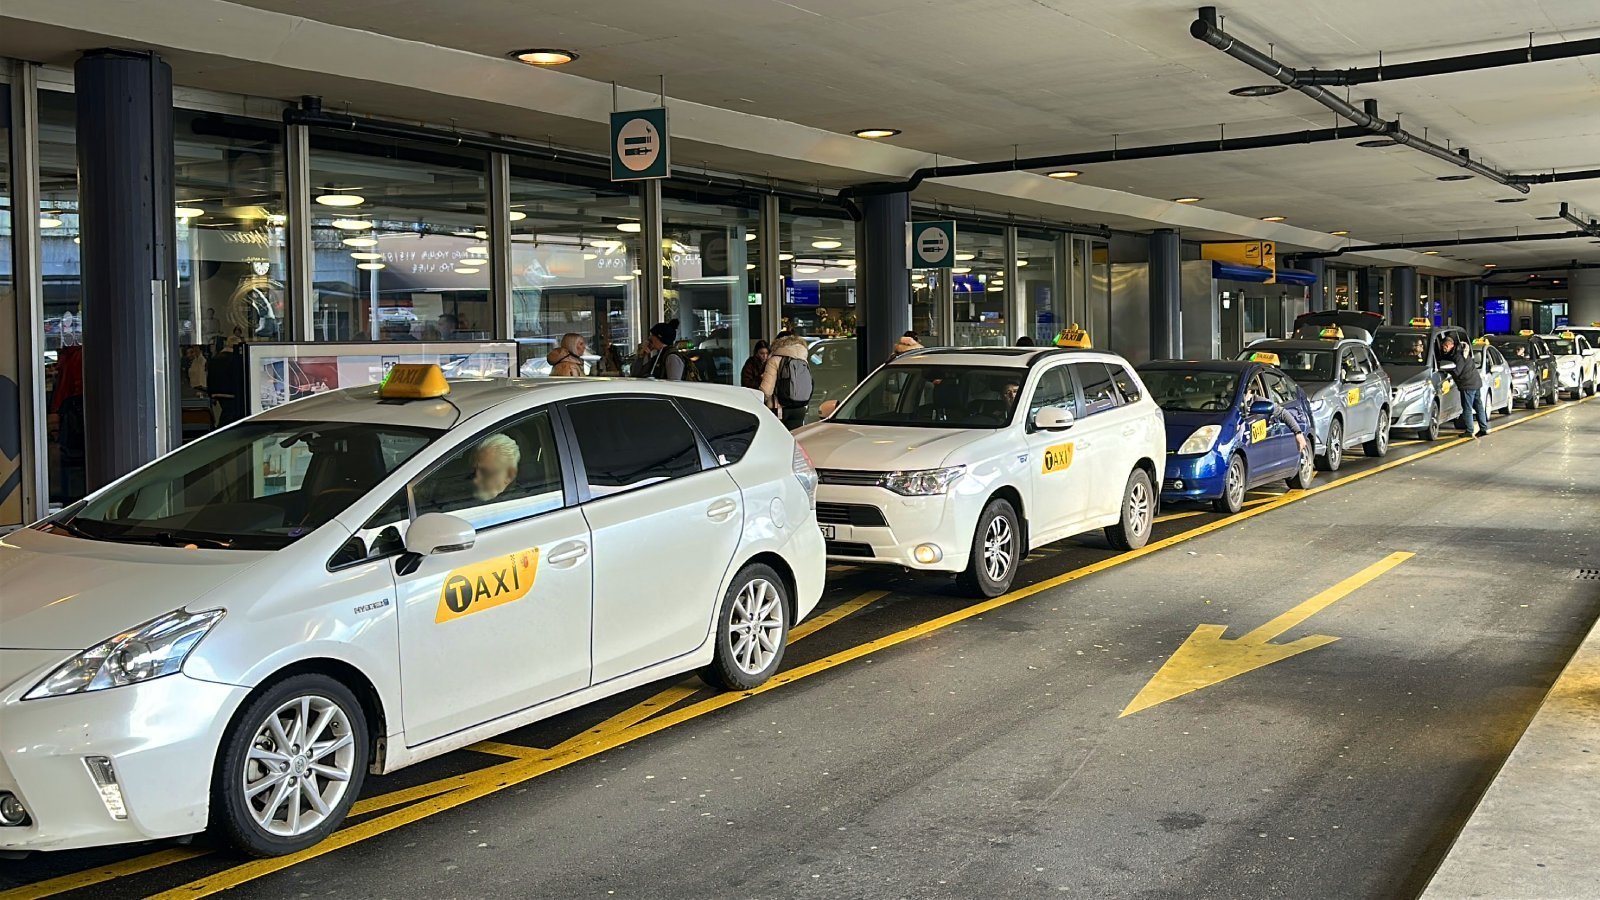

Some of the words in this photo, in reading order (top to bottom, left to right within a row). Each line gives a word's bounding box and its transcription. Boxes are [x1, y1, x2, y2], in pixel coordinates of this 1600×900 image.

[1264, 244, 1273, 256] 2
[391, 367, 420, 385] TAXI
[1045, 449, 1068, 470] TAXI
[446, 560, 520, 612] TAXI
